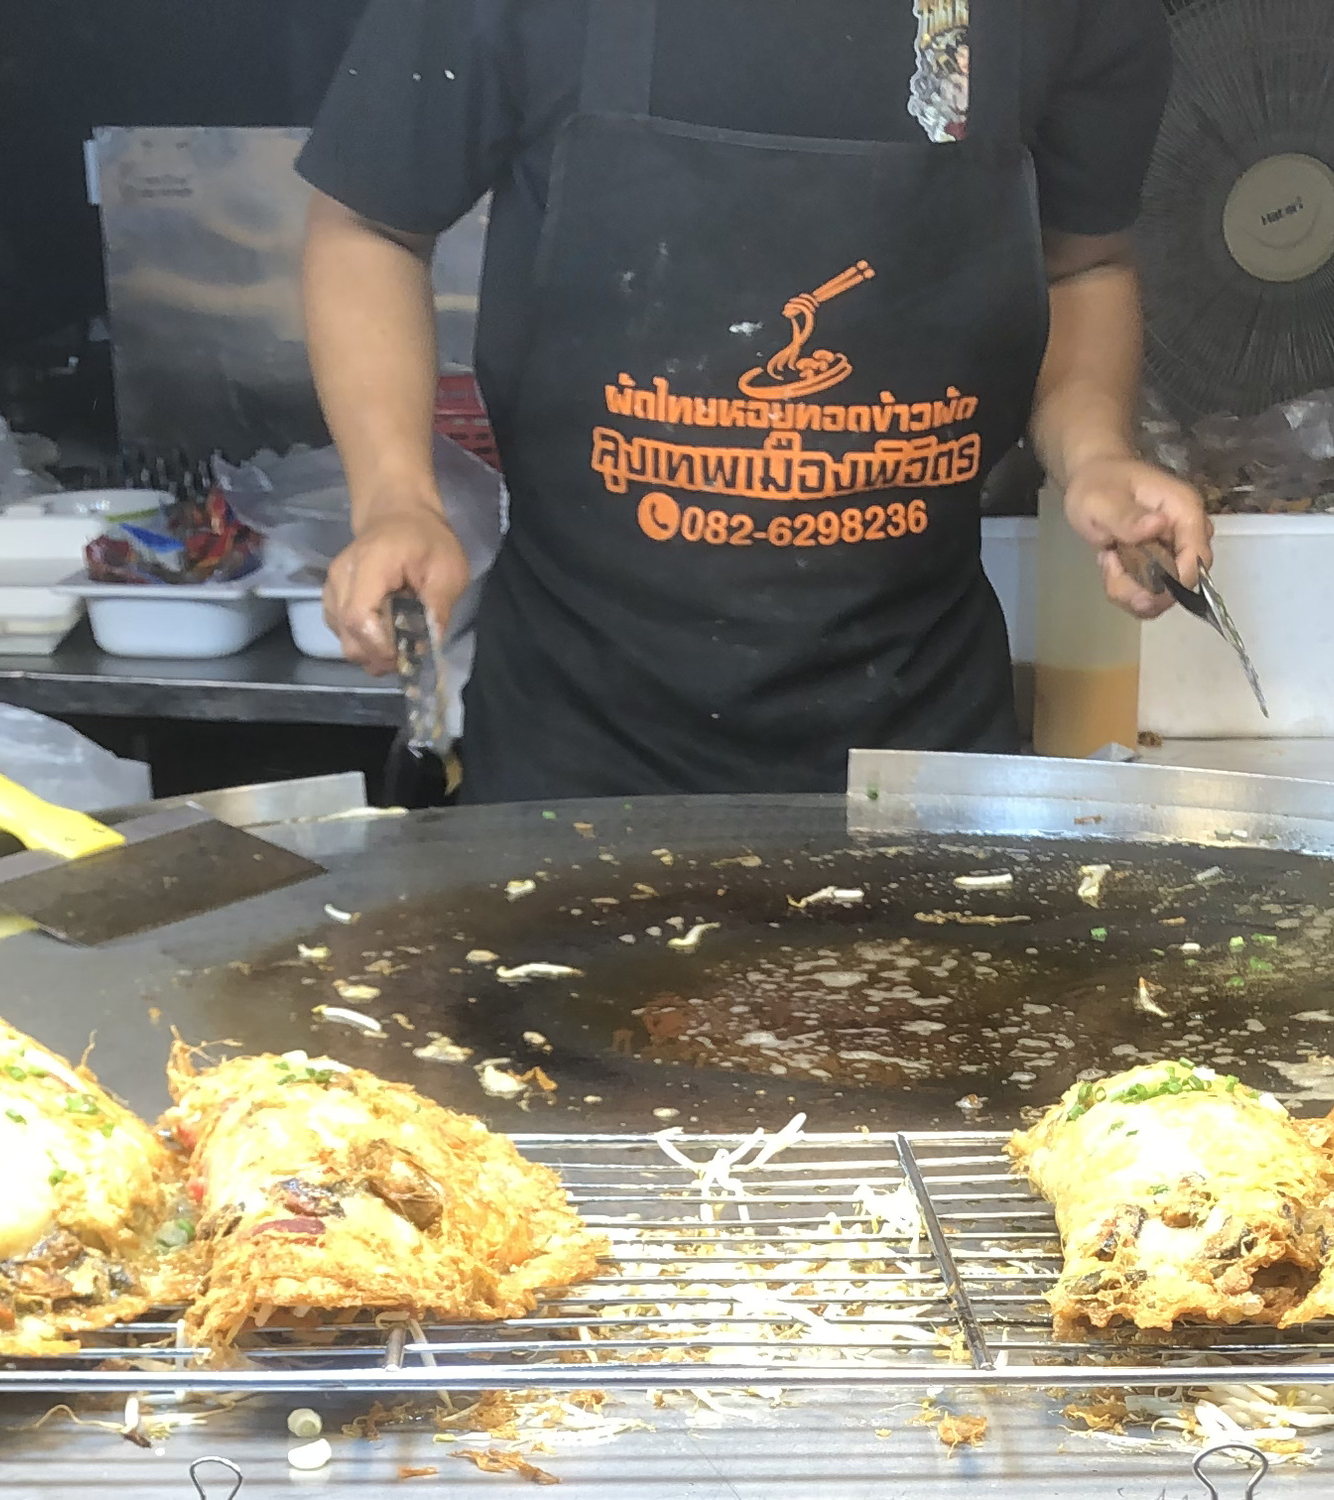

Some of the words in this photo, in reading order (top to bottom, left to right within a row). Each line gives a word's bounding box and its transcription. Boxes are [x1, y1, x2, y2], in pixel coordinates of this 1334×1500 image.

[604, 372, 979, 434] ผัดไทยหอยทอดข้าวผัด
[679, 499, 928, 547] 082-6298236
